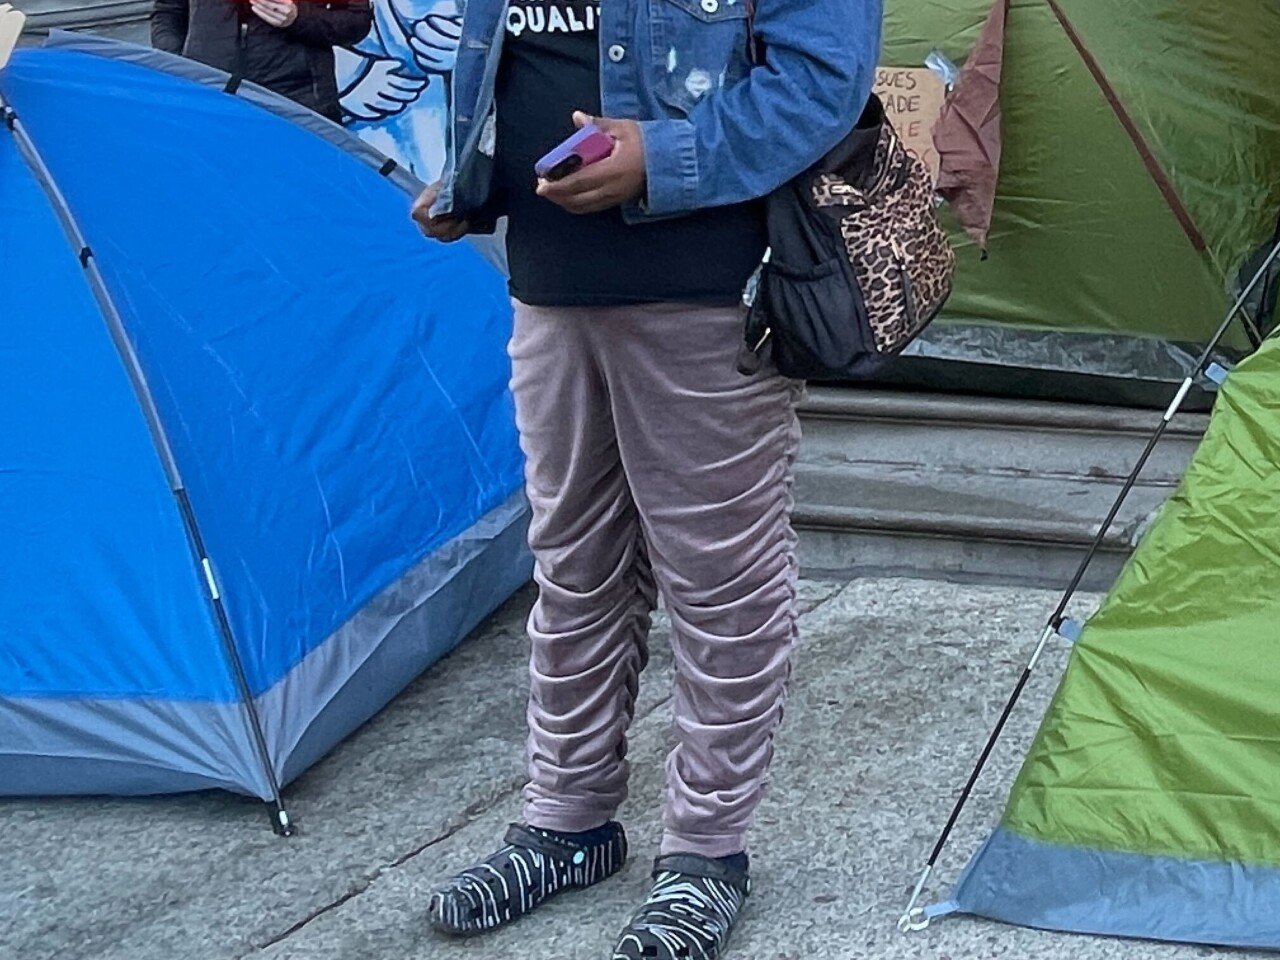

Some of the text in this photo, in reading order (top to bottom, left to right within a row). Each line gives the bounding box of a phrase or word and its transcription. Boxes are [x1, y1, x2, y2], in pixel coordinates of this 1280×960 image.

[506, 6, 601, 36] QUALI
[877, 70, 917, 90] SUES
[880, 92, 921, 113] ADE
